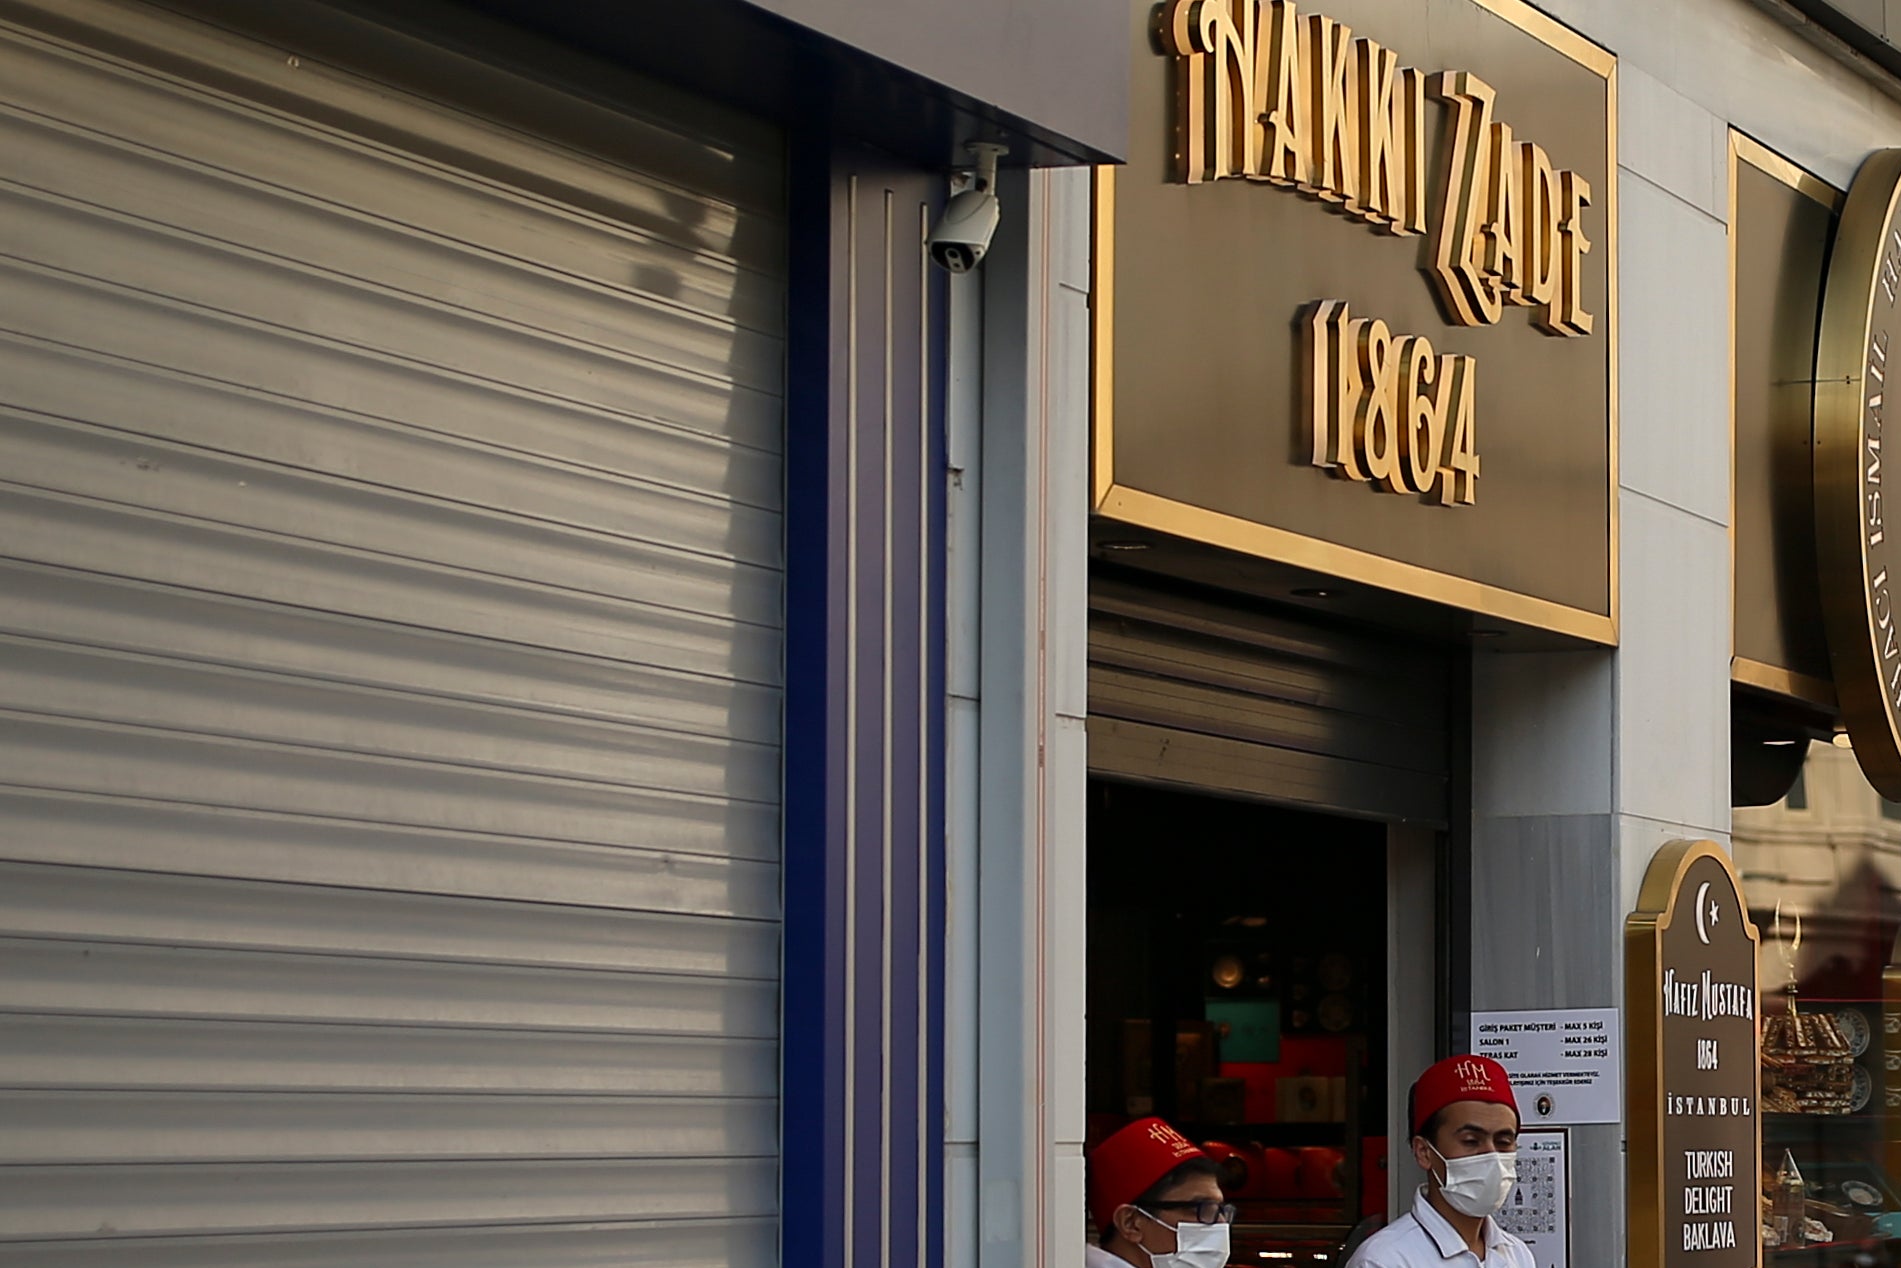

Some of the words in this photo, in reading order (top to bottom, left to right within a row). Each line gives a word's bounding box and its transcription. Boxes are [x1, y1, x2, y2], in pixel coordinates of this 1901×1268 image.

[1174, 0, 1427, 236] HAKKI
[1437, 71, 1594, 338] ZADE
[1312, 300, 1481, 507] 1864
[1664, 969, 1699, 1017] HAFIZ
[1702, 970, 1754, 1021] MUSTAFA
[1479, 1038, 1504, 1046] SALON
[1565, 1036, 1581, 1044] MAX
[1500, 1023, 1523, 1032] PAKET
[1565, 1022, 1581, 1030] MAX
[1504, 1051, 1518, 1059] KAT
[1565, 1050, 1581, 1058] MAX
[1697, 1038, 1719, 1070] 1864
[1454, 1060, 1491, 1081] HM
[1668, 1092, 1750, 1116] İSTANBUL
[1684, 1150, 1734, 1180] TURKISH
[1684, 1186, 1734, 1214] DELIGHT
[1683, 1221, 1736, 1251] BAKLAVA
